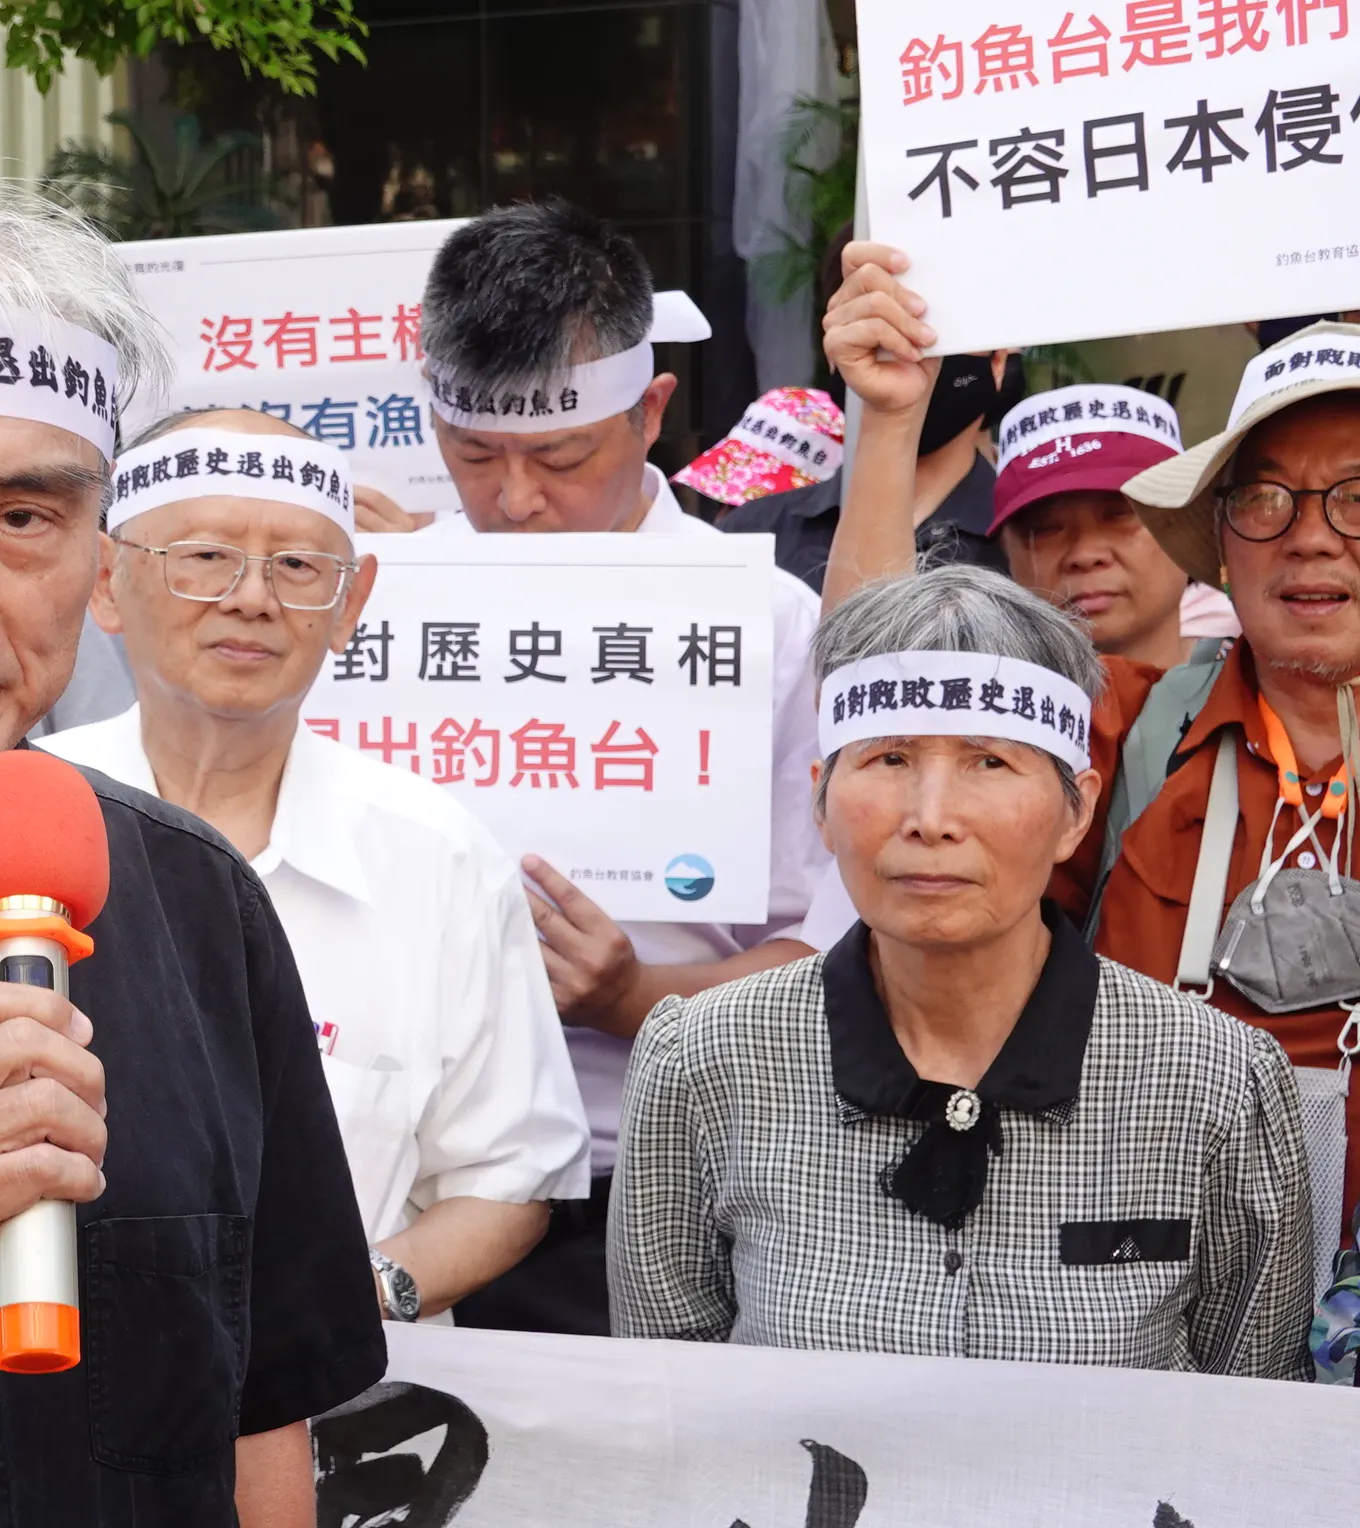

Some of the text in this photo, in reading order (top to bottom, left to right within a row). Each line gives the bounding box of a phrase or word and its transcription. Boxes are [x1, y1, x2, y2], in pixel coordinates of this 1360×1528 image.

[898, 0, 1349, 106] 釣魚台是我們
[905, 83, 1360, 219] 不容日本侵
[184, 393, 425, 449] 有漁
[303, 716, 712, 792] 出釣魚台！
